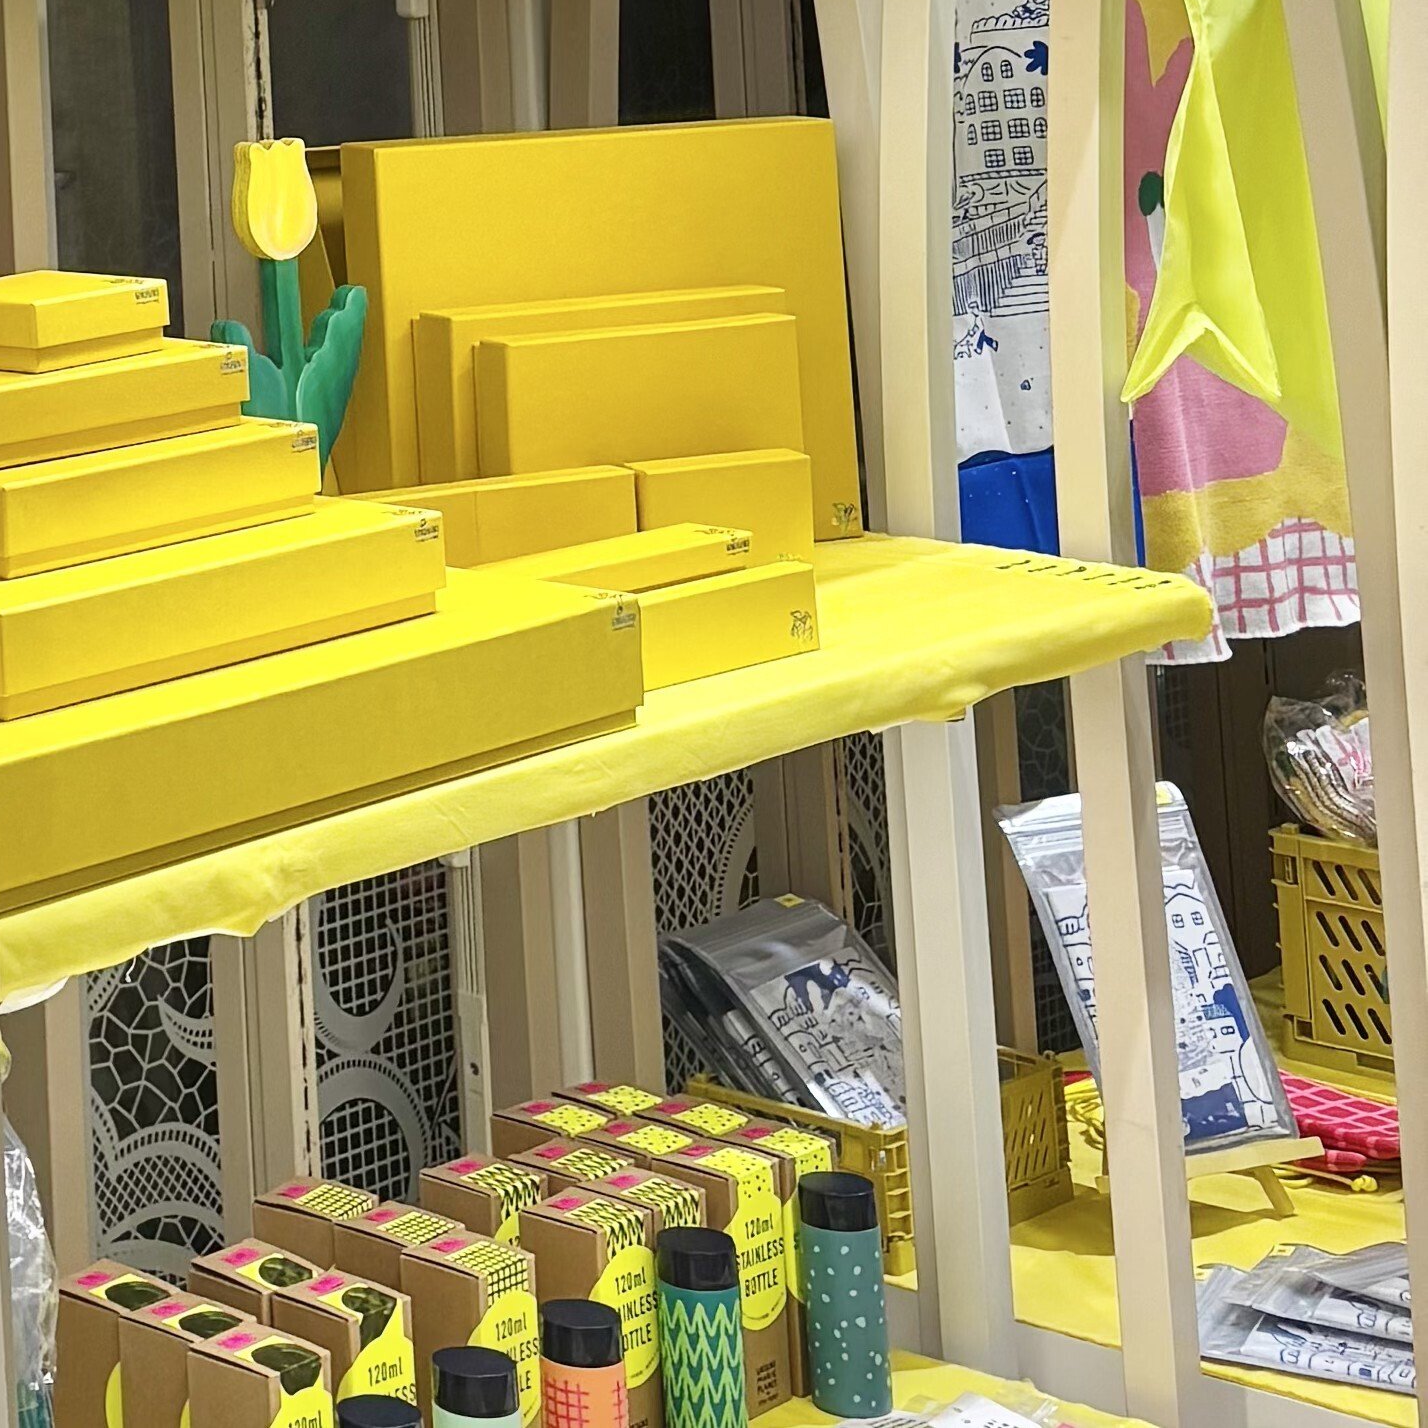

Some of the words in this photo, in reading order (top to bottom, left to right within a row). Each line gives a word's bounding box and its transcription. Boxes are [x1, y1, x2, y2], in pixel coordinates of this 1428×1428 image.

[745, 1212, 775, 1240] 120ml
[615, 1266, 647, 1296] 120ml
[744, 1267, 779, 1297] BOTTLE
[495, 1311, 528, 1342] 120ml
[621, 1322, 653, 1354] OTTLE
[367, 1356, 403, 1387] 120ml
